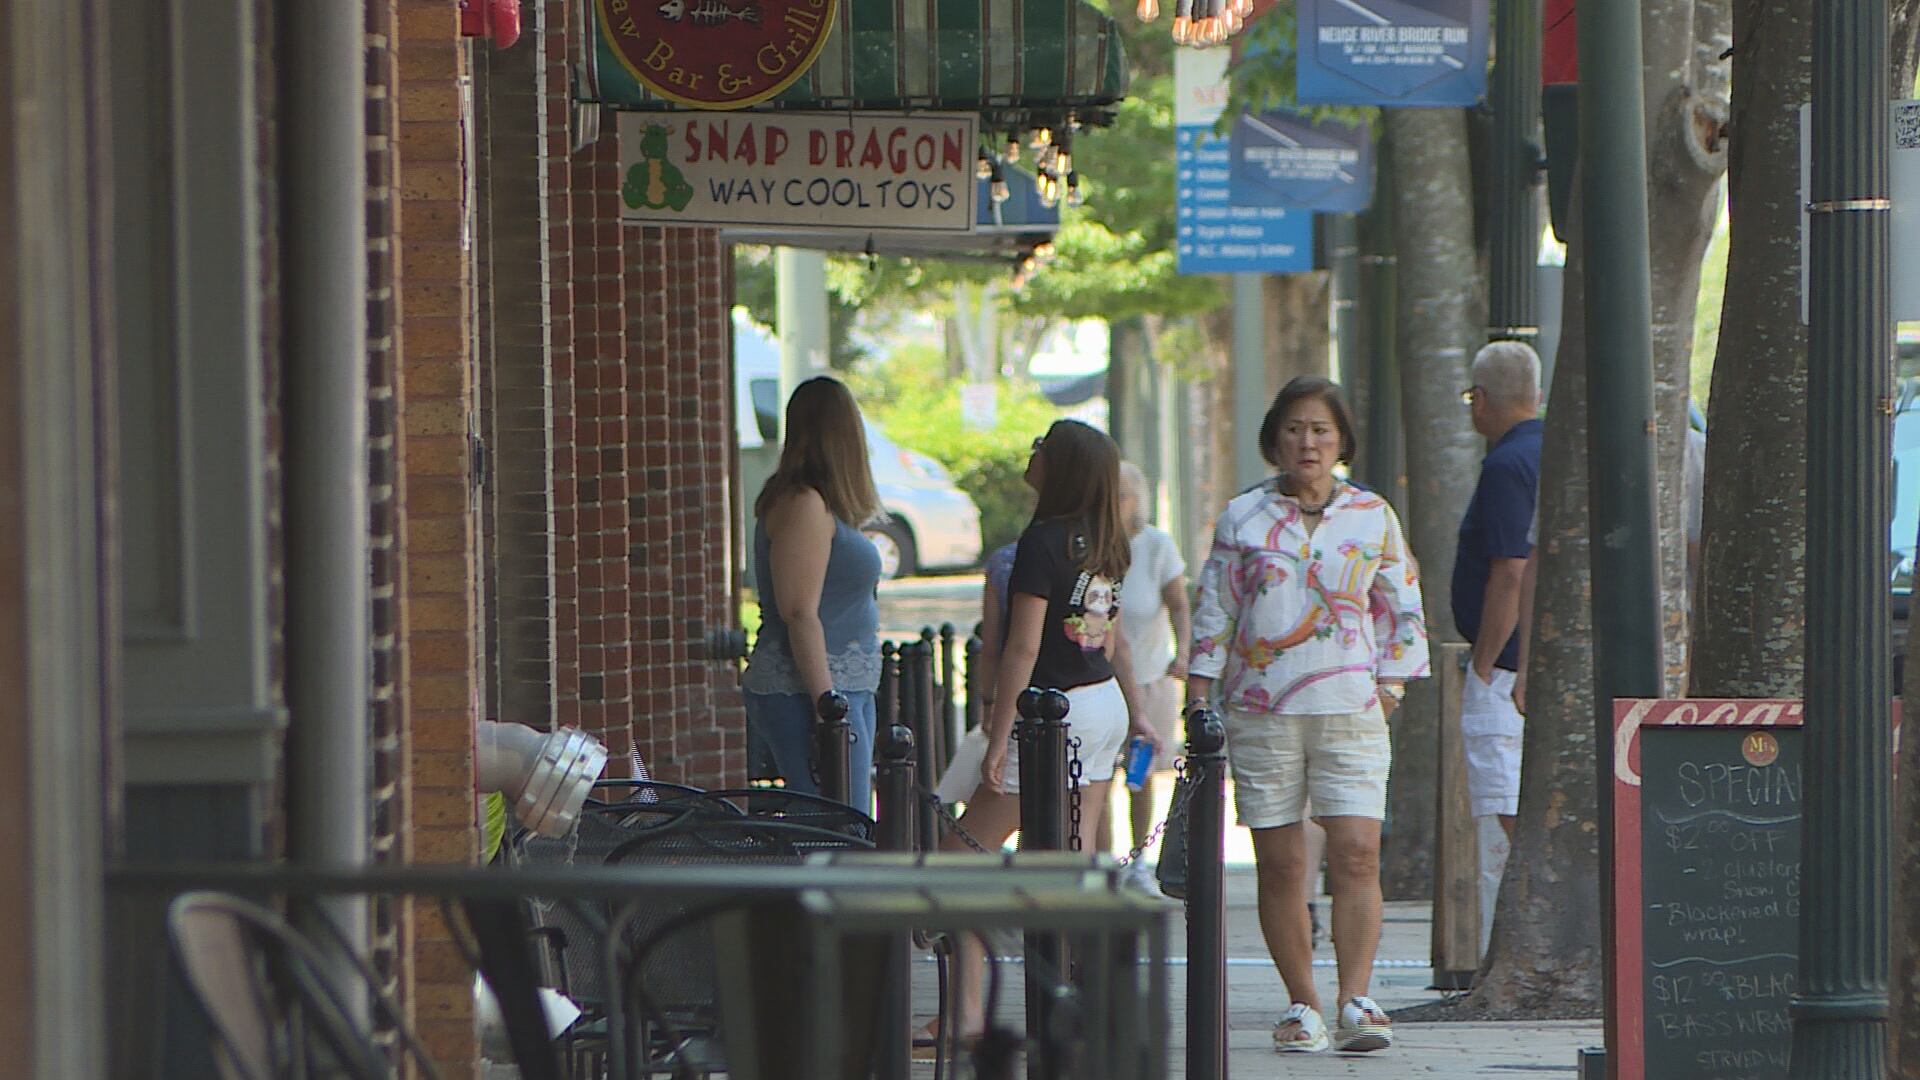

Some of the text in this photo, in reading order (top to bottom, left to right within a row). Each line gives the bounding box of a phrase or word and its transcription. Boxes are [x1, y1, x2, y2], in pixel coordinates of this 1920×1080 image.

[612, 0, 824, 94] aw Bar & Grille
[1319, 26, 1469, 43] NEUSE RIVER BRIDGE RUN
[685, 119, 964, 174] SNAP DRAGON
[708, 177, 955, 210] WAY COOL TOYS
[1730, 829, 1787, 853] OFF
[1656, 1011, 1733, 1040] BASS
